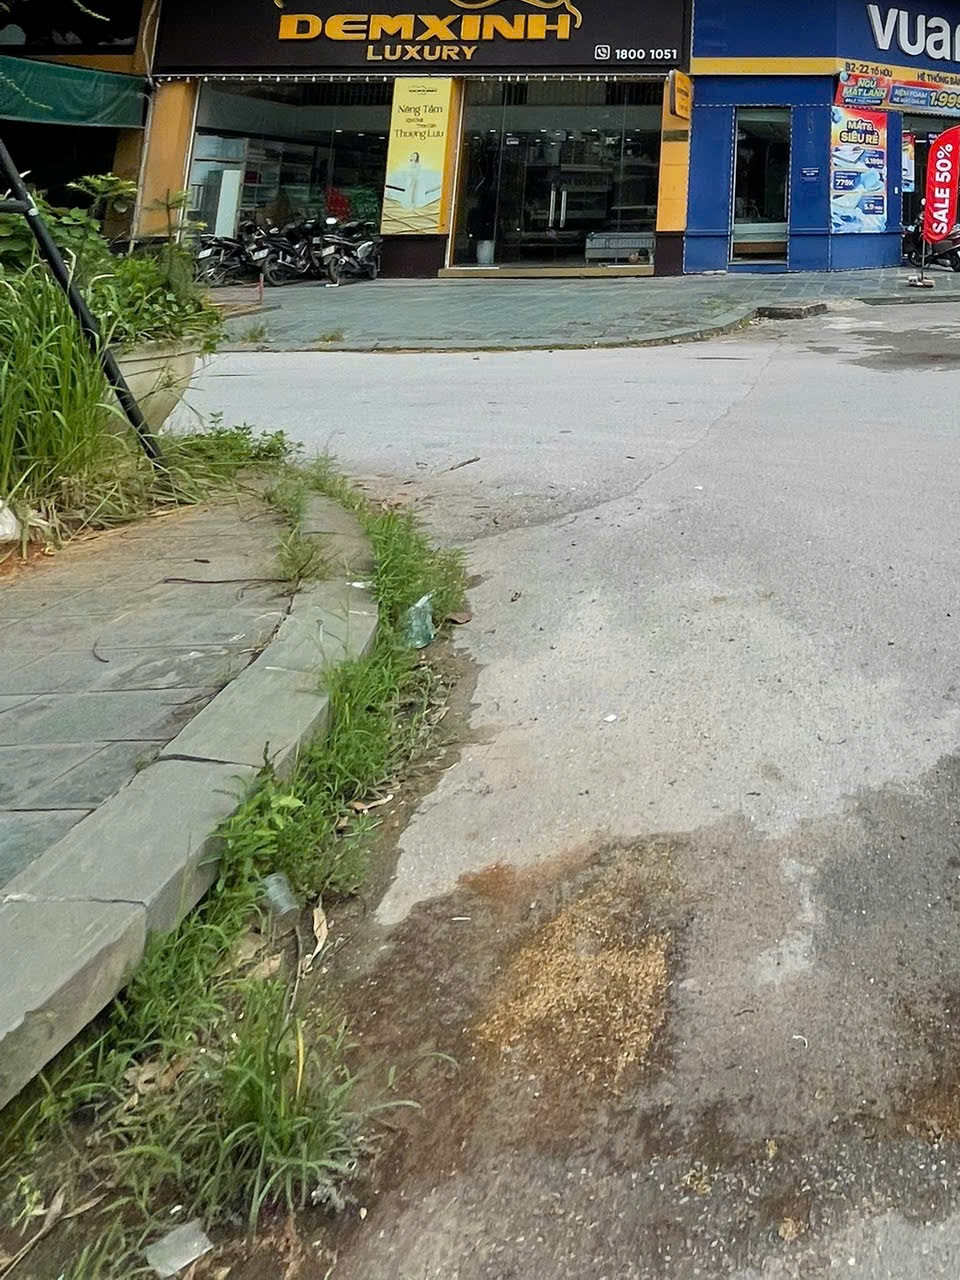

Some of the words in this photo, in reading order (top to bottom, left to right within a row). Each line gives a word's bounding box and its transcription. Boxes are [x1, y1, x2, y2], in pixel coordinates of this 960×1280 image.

[277, 13, 571, 41] DEMXINH
[366, 45, 479, 62] LUXURY
[615, 47, 646, 61] 1800
[649, 47, 678, 61] 1051
[845, 62, 870, 75] B2-22
[935, 143, 953, 183] 50%
[932, 187, 950, 234] SALE
